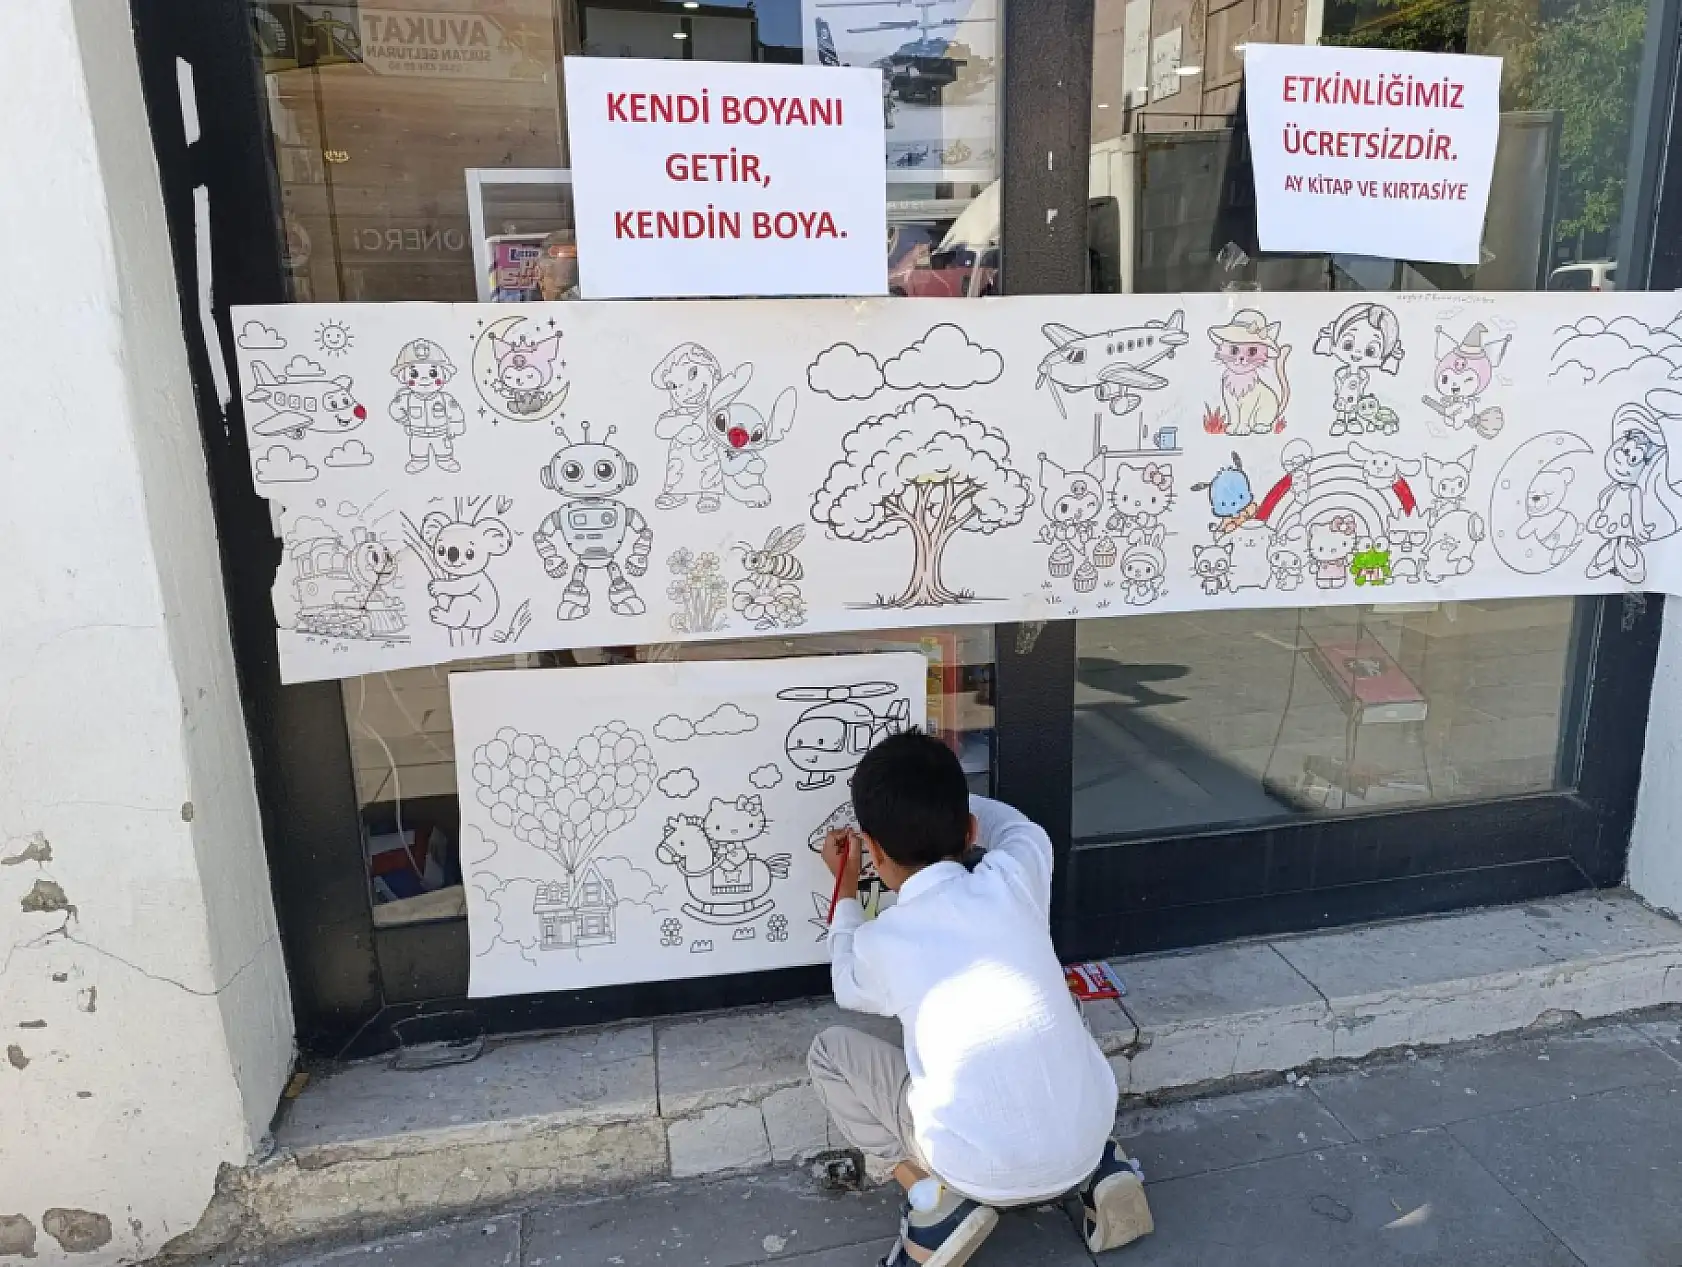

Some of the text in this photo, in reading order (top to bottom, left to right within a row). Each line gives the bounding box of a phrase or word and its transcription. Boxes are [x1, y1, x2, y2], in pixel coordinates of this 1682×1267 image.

[606, 88, 844, 127] KENDİ BOYANI
[1282, 71, 1465, 110] ETKİNLİĞİMİZ
[1283, 122, 1458, 162] ÜCRETSİZDİR.
[665, 147, 771, 189] GETİR,
[1284, 174, 1468, 201] AY KİTAP VE KIRTASİYE
[614, 203, 849, 240] KENDİN BOYA.
